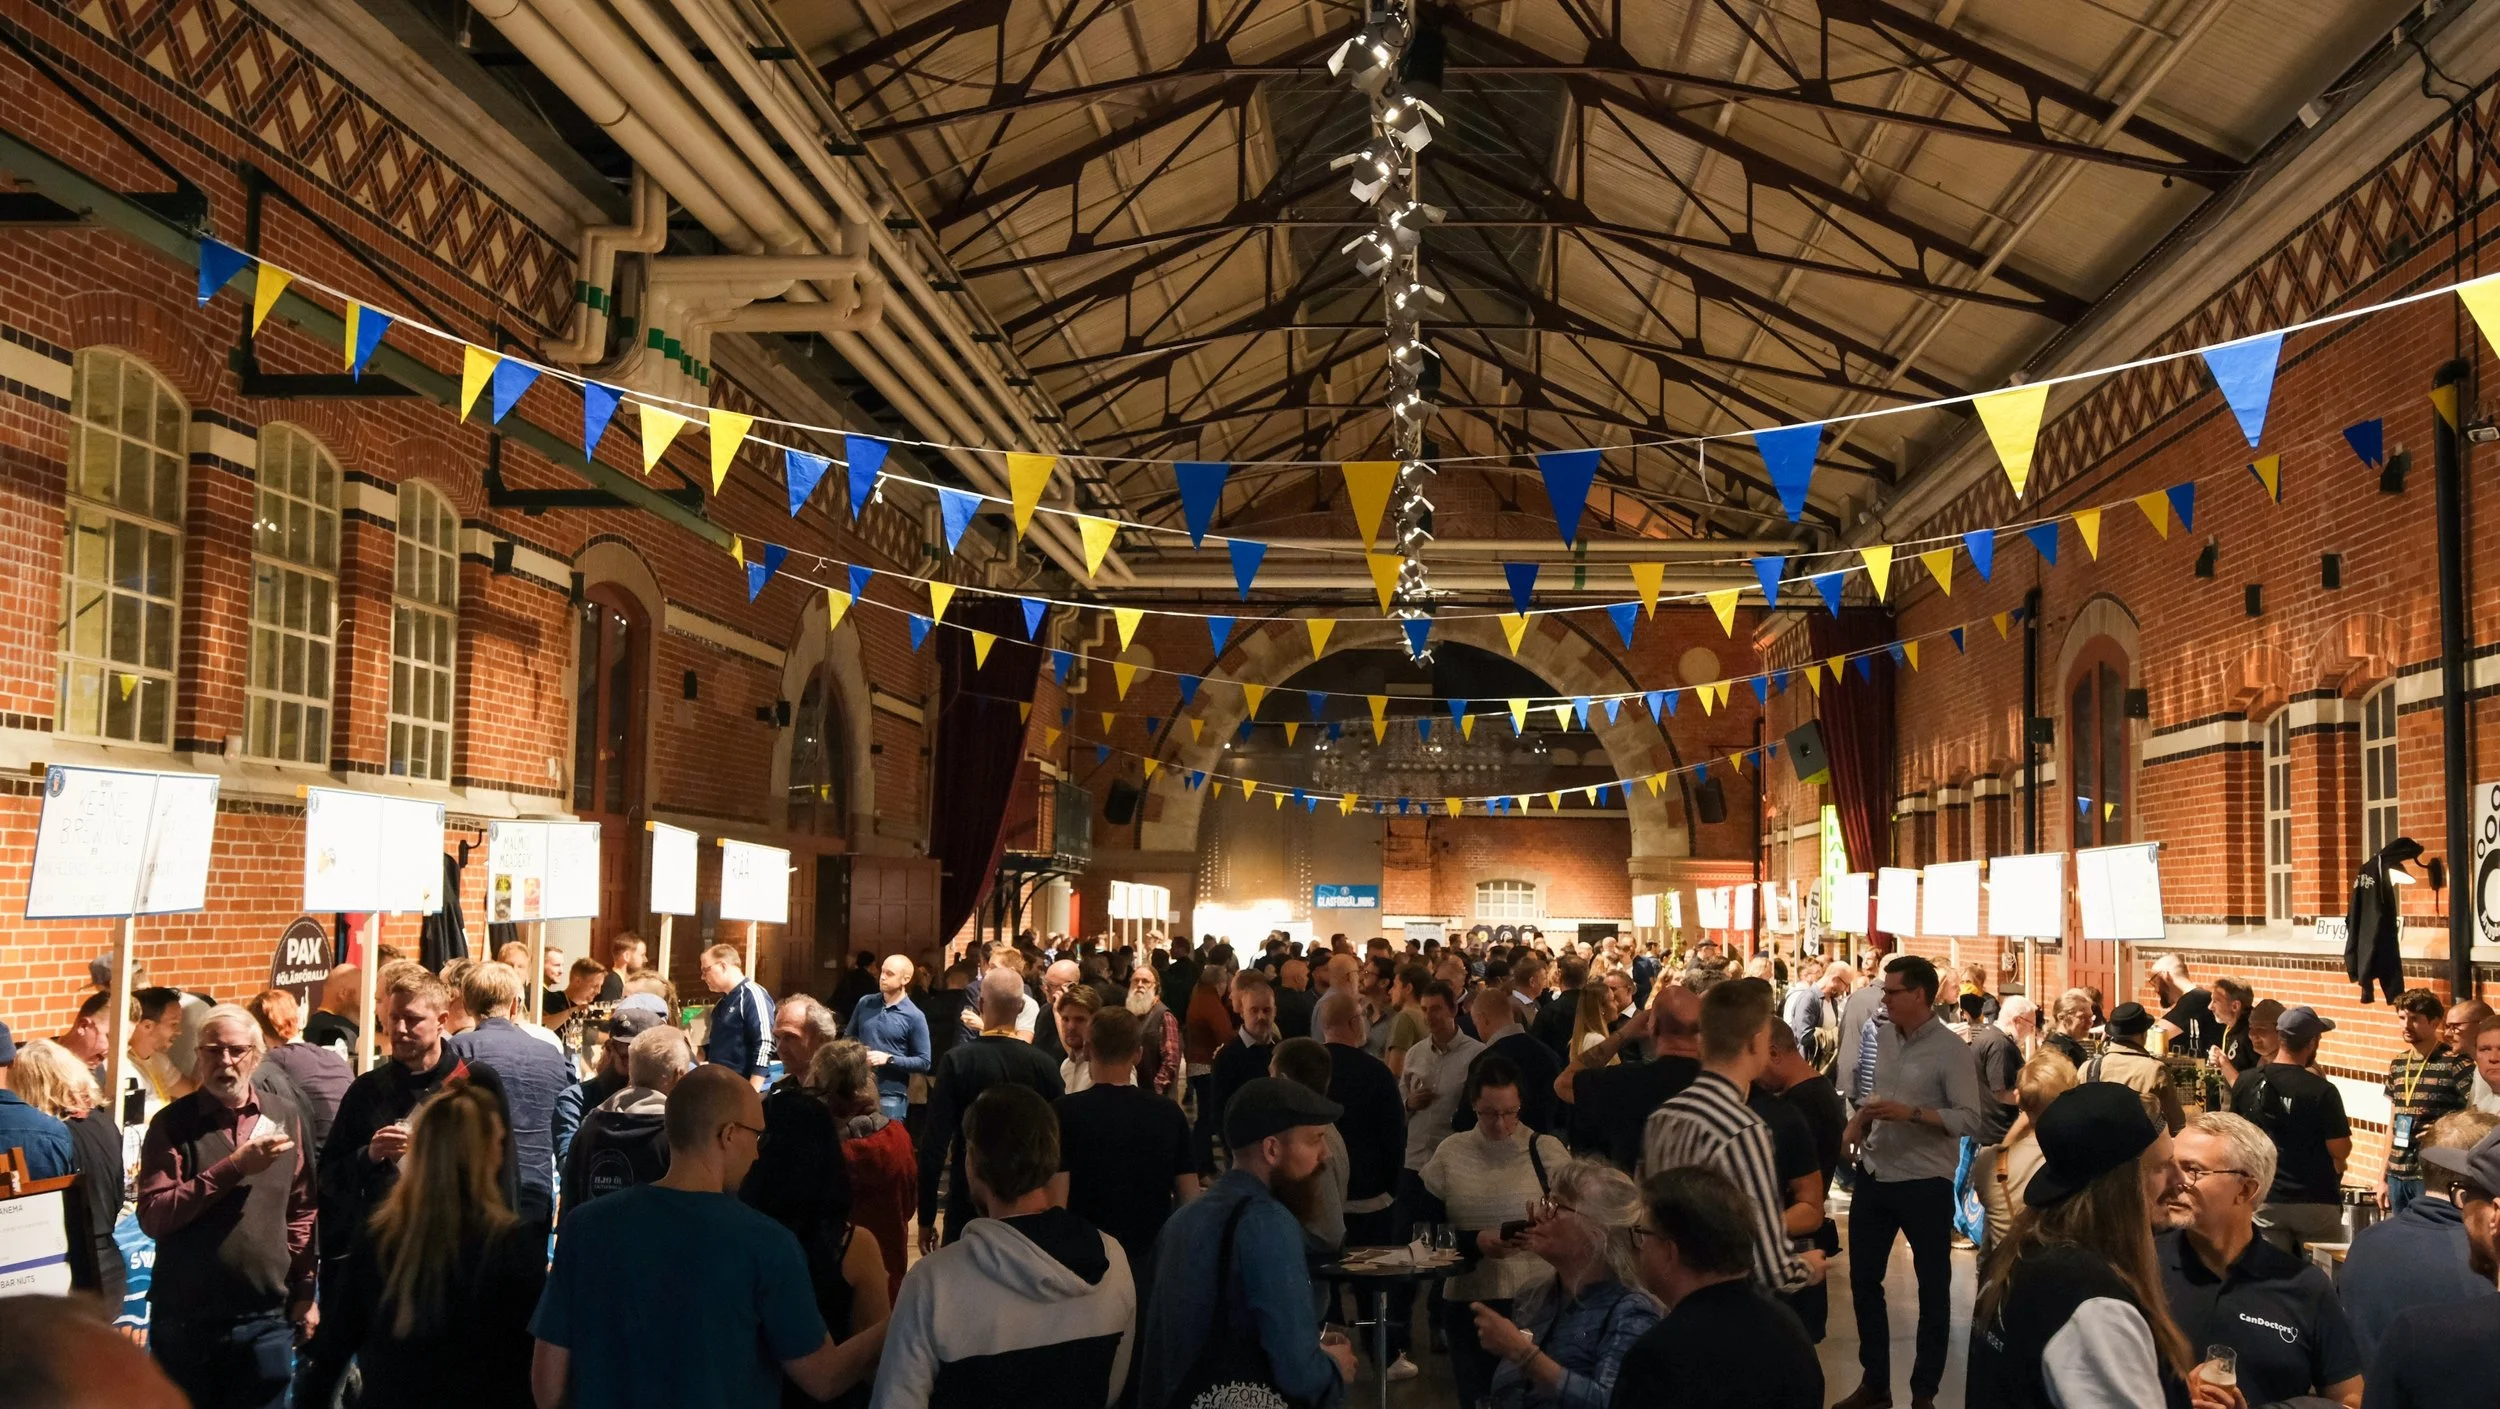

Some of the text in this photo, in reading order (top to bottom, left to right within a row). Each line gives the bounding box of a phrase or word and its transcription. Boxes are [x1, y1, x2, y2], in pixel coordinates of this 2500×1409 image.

[1809, 891, 1819, 956] NOTCH
[286, 937, 322, 966] PAX
[0, 1274, 36, 1290] BAR NUTS
[2239, 1312, 2294, 1334] CanDoctors
[1225, 1387, 1284, 1408] PORTER
